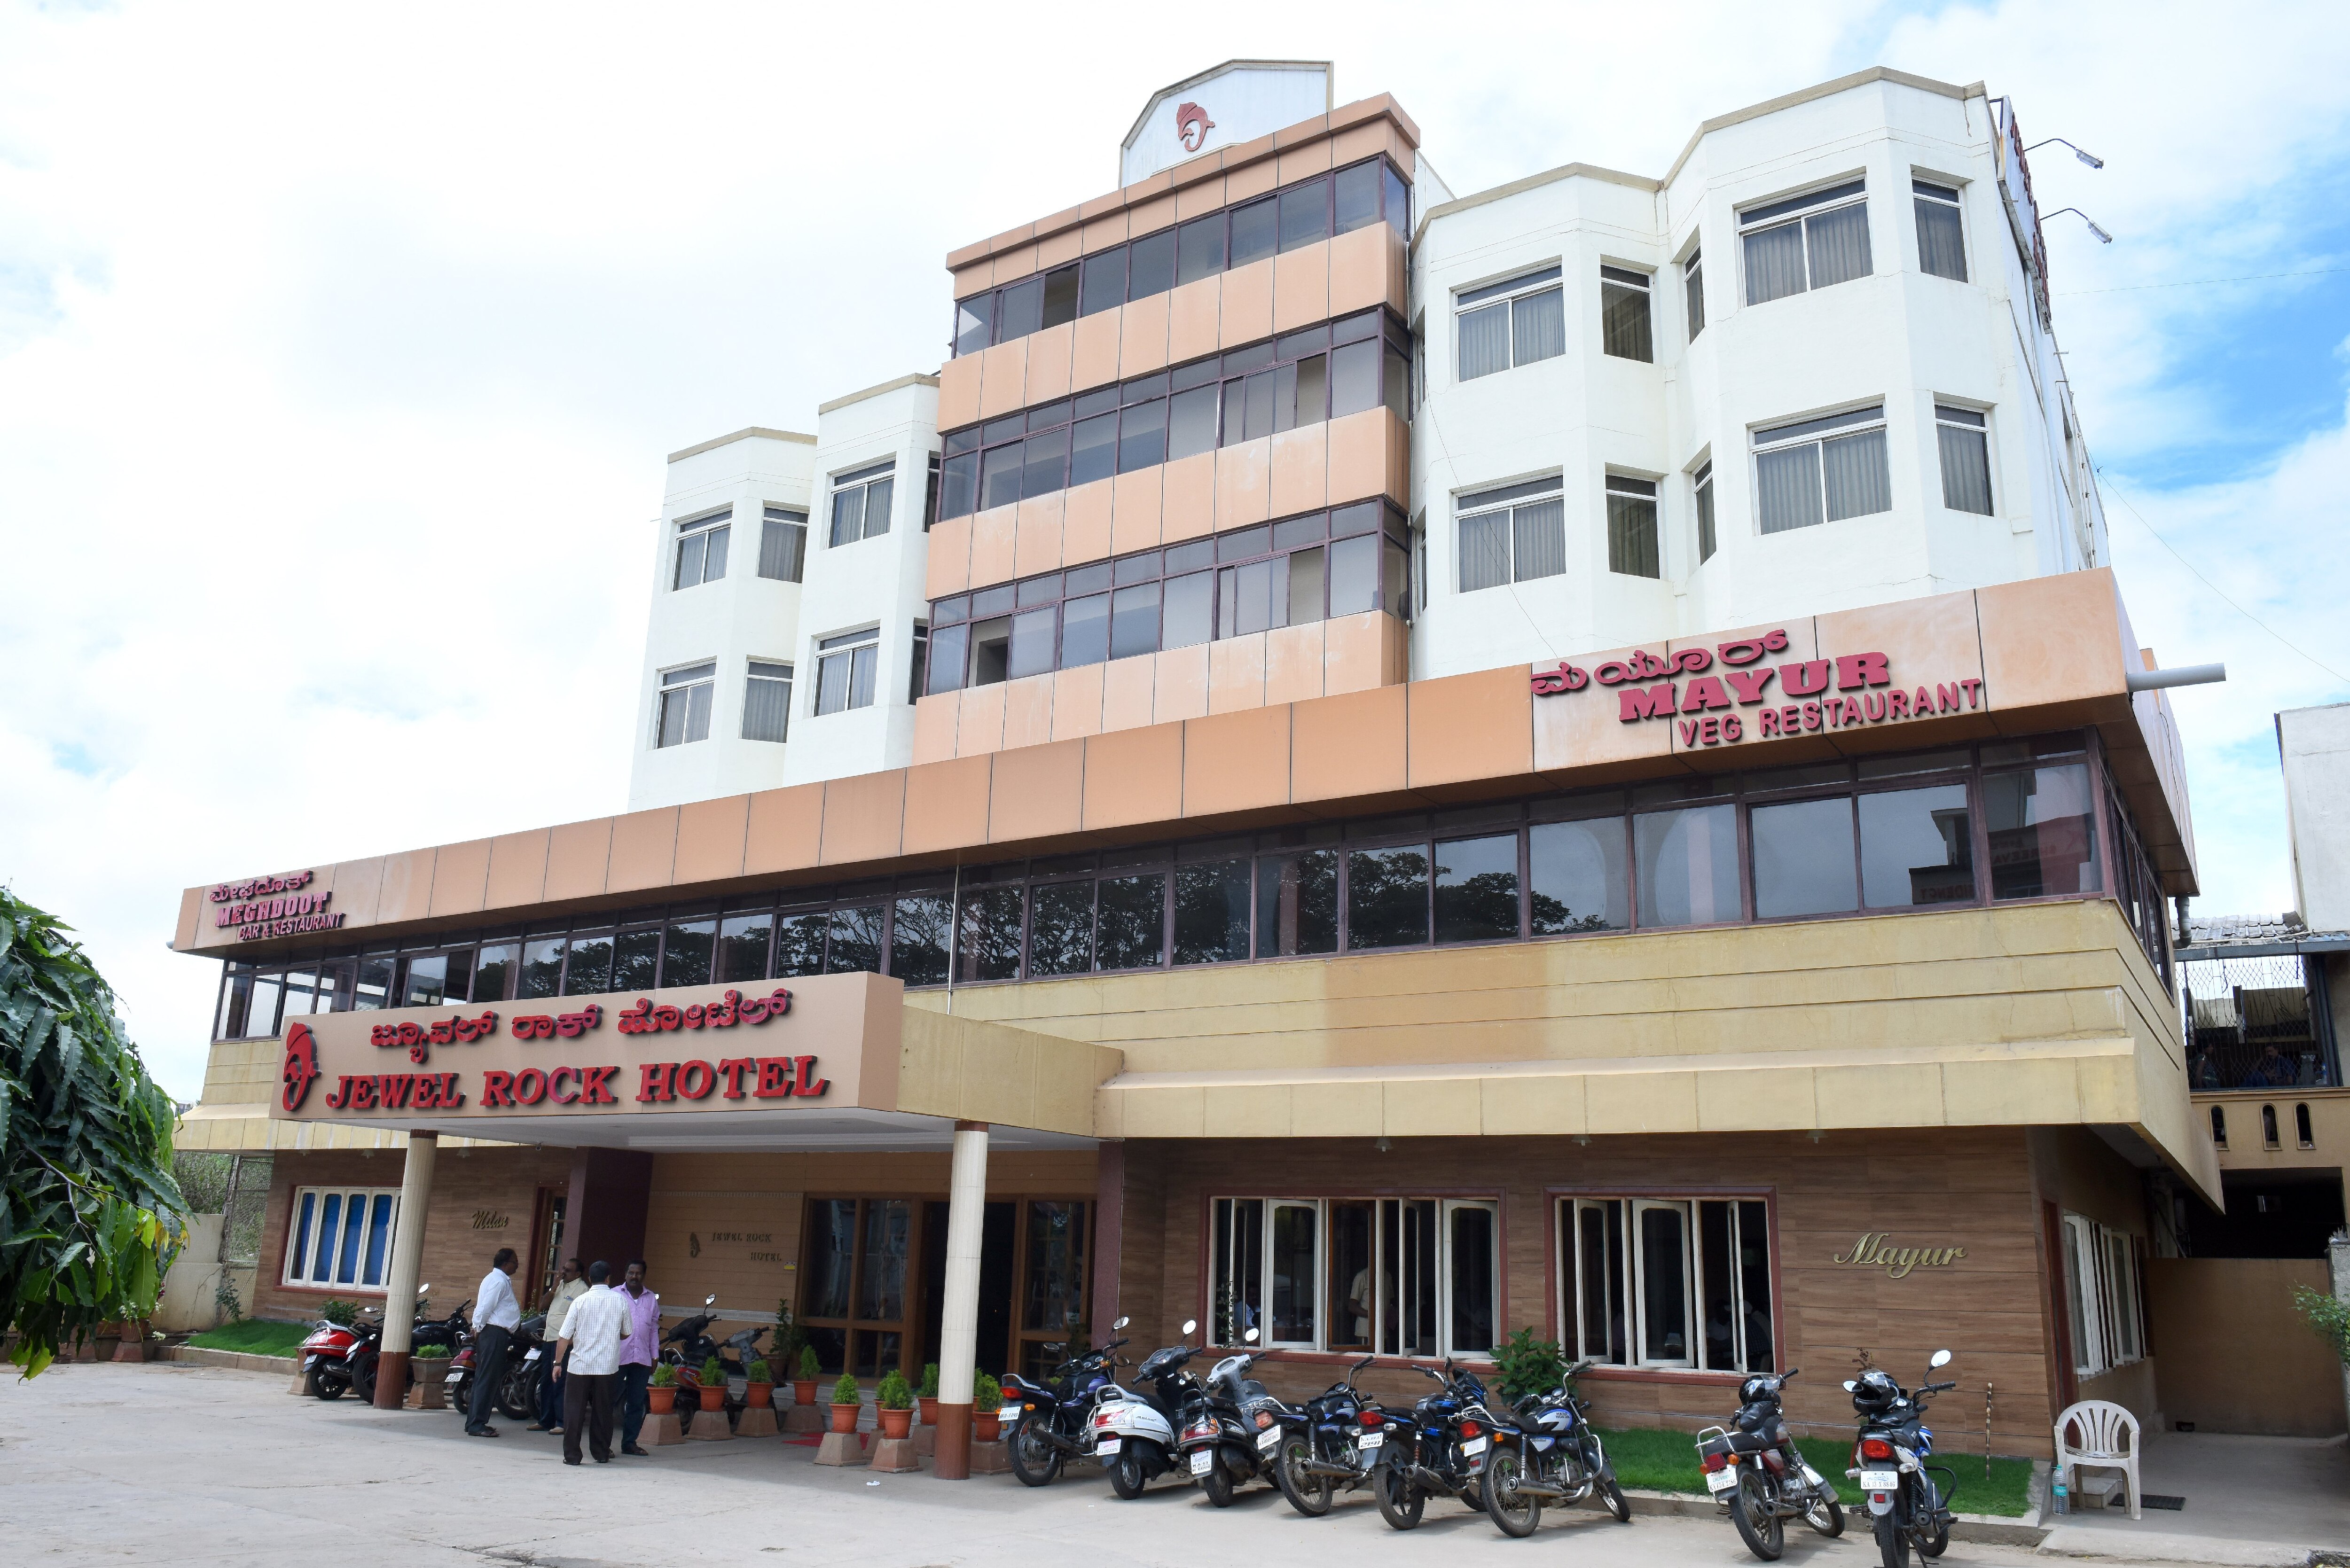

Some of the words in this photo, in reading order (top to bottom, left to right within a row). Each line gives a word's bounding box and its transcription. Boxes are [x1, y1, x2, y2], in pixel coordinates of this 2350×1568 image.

[1530, 629, 1790, 696] ಮಯೂರ್
[1618, 651, 1891, 723] MAYUR
[1677, 713, 1742, 747] VEG
[1759, 678, 1982, 736] RESTAURANT
[216, 892, 329, 928] MEGHDOOT
[239, 924, 261, 940] BAR
[262, 923, 273, 937] &
[274, 913, 344, 936] RESTAURANT
[511, 1004, 603, 1039] ರಾಕ್
[618, 988, 793, 1035] ಹೋಟೆಲ್
[325, 1072, 466, 1109] JEWEL
[479, 1065, 619, 1107] ROCK
[635, 1054, 832, 1103] HOTEL
[712, 1232, 742, 1241] JEWEL
[746, 1233, 771, 1242] ROCK
[751, 1252, 782, 1262] HOTEL
[1833, 1233, 1968, 1279] Mayur
